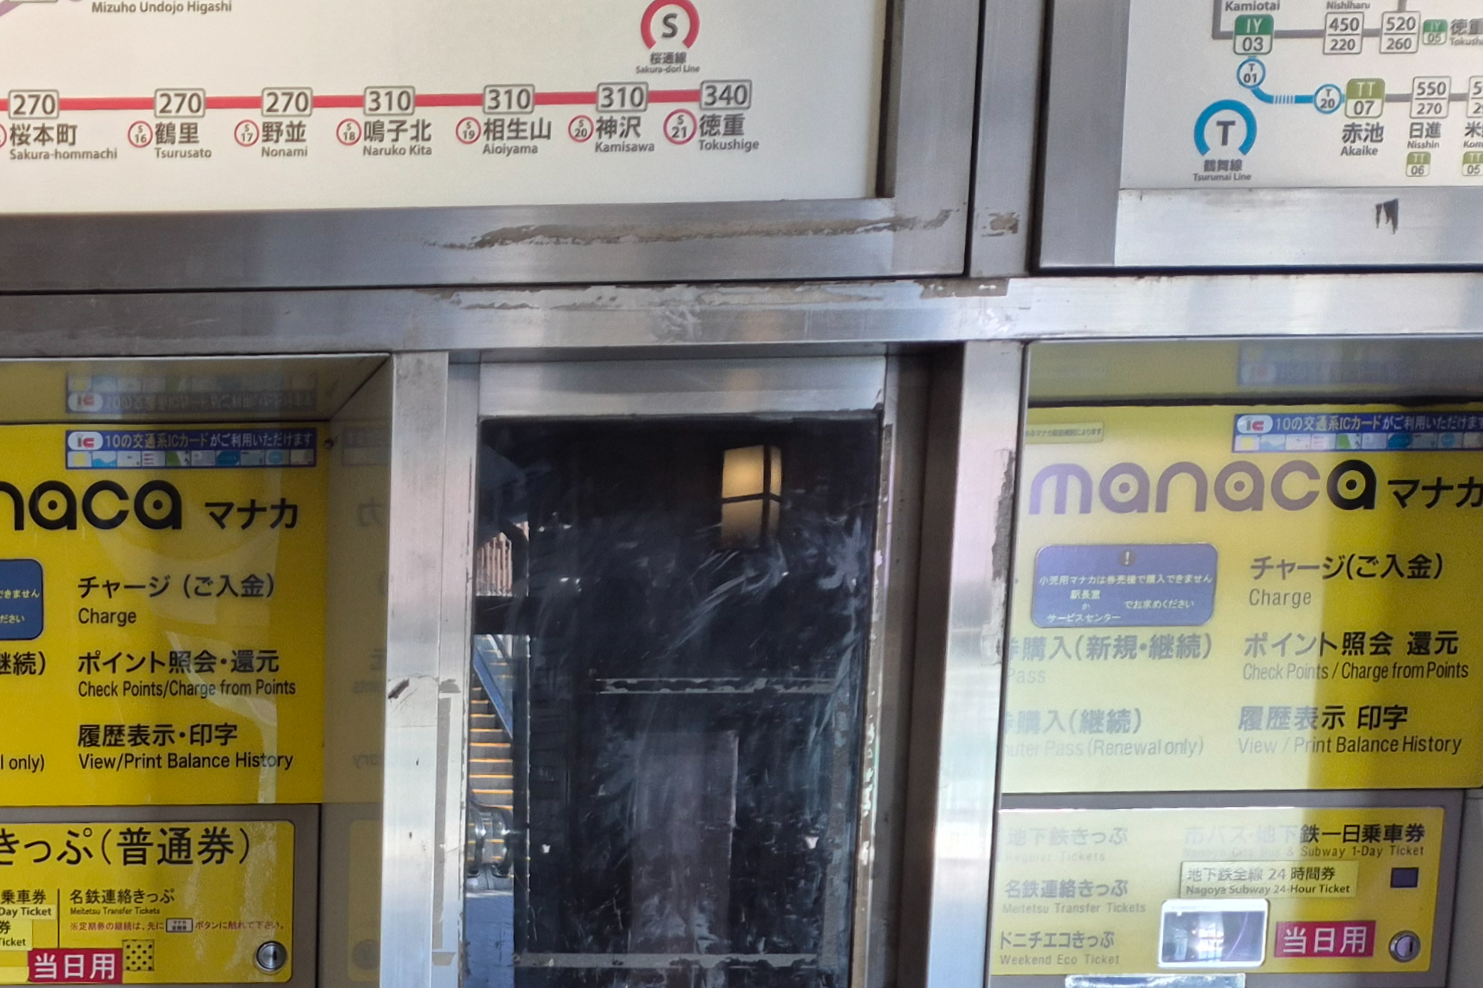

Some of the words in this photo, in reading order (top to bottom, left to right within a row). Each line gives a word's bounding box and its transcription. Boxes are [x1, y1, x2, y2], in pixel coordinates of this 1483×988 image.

[1247, 19, 1262, 33] IY
[1329, 17, 1359, 32] 450
[1240, 36, 1265, 52] 03
[486, 86, 531, 111] 310
[702, 83, 750, 109] 340
[10, 123, 77, 146] 桜本町
[155, 122, 199, 145] 鶴里
[364, 119, 431, 142] 鳴子北
[483, 117, 551, 141] 相生山
[596, 116, 640, 139] 神沢
[700, 113, 745, 137] 徳重
[1342, 122, 1384, 143] 赤池
[1410, 122, 1441, 139] 日進
[10, 148, 117, 160] Sakura-hommachi
[155, 147, 211, 158] Tsurusato
[483, 143, 538, 157] Aioiyama
[595, 141, 654, 152] Kamisawa
[699, 139, 759, 152] Tokushige
[1340, 145, 1378, 156] Akaike
[1407, 140, 1439, 149] Nisshin
[1204, 159, 1242, 172] 鶴舞線
[1194, 173, 1231, 181] Tsurumai
[1234, 173, 1251, 181] Line
[1029, 459, 1378, 515] manaca
[205, 497, 298, 530] マナカ
[75, 572, 279, 602] チャージ（ご入金）
[79, 608, 136, 627] Charge
[1244, 631, 1395, 658] ポイント照会
[1407, 631, 1458, 655] 還元
[79, 650, 279, 674] ポイント照会・還元
[78, 723, 237, 747] 履歴表示・印字
[70, 888, 175, 904] 名鉄連絡きっぷ
[21, 907, 51, 915] Ticket
[1001, 931, 1115, 949] ドニチエコきっぷ
[1281, 924, 1366, 956] 当日用
[35, 953, 114, 979] 当日用
